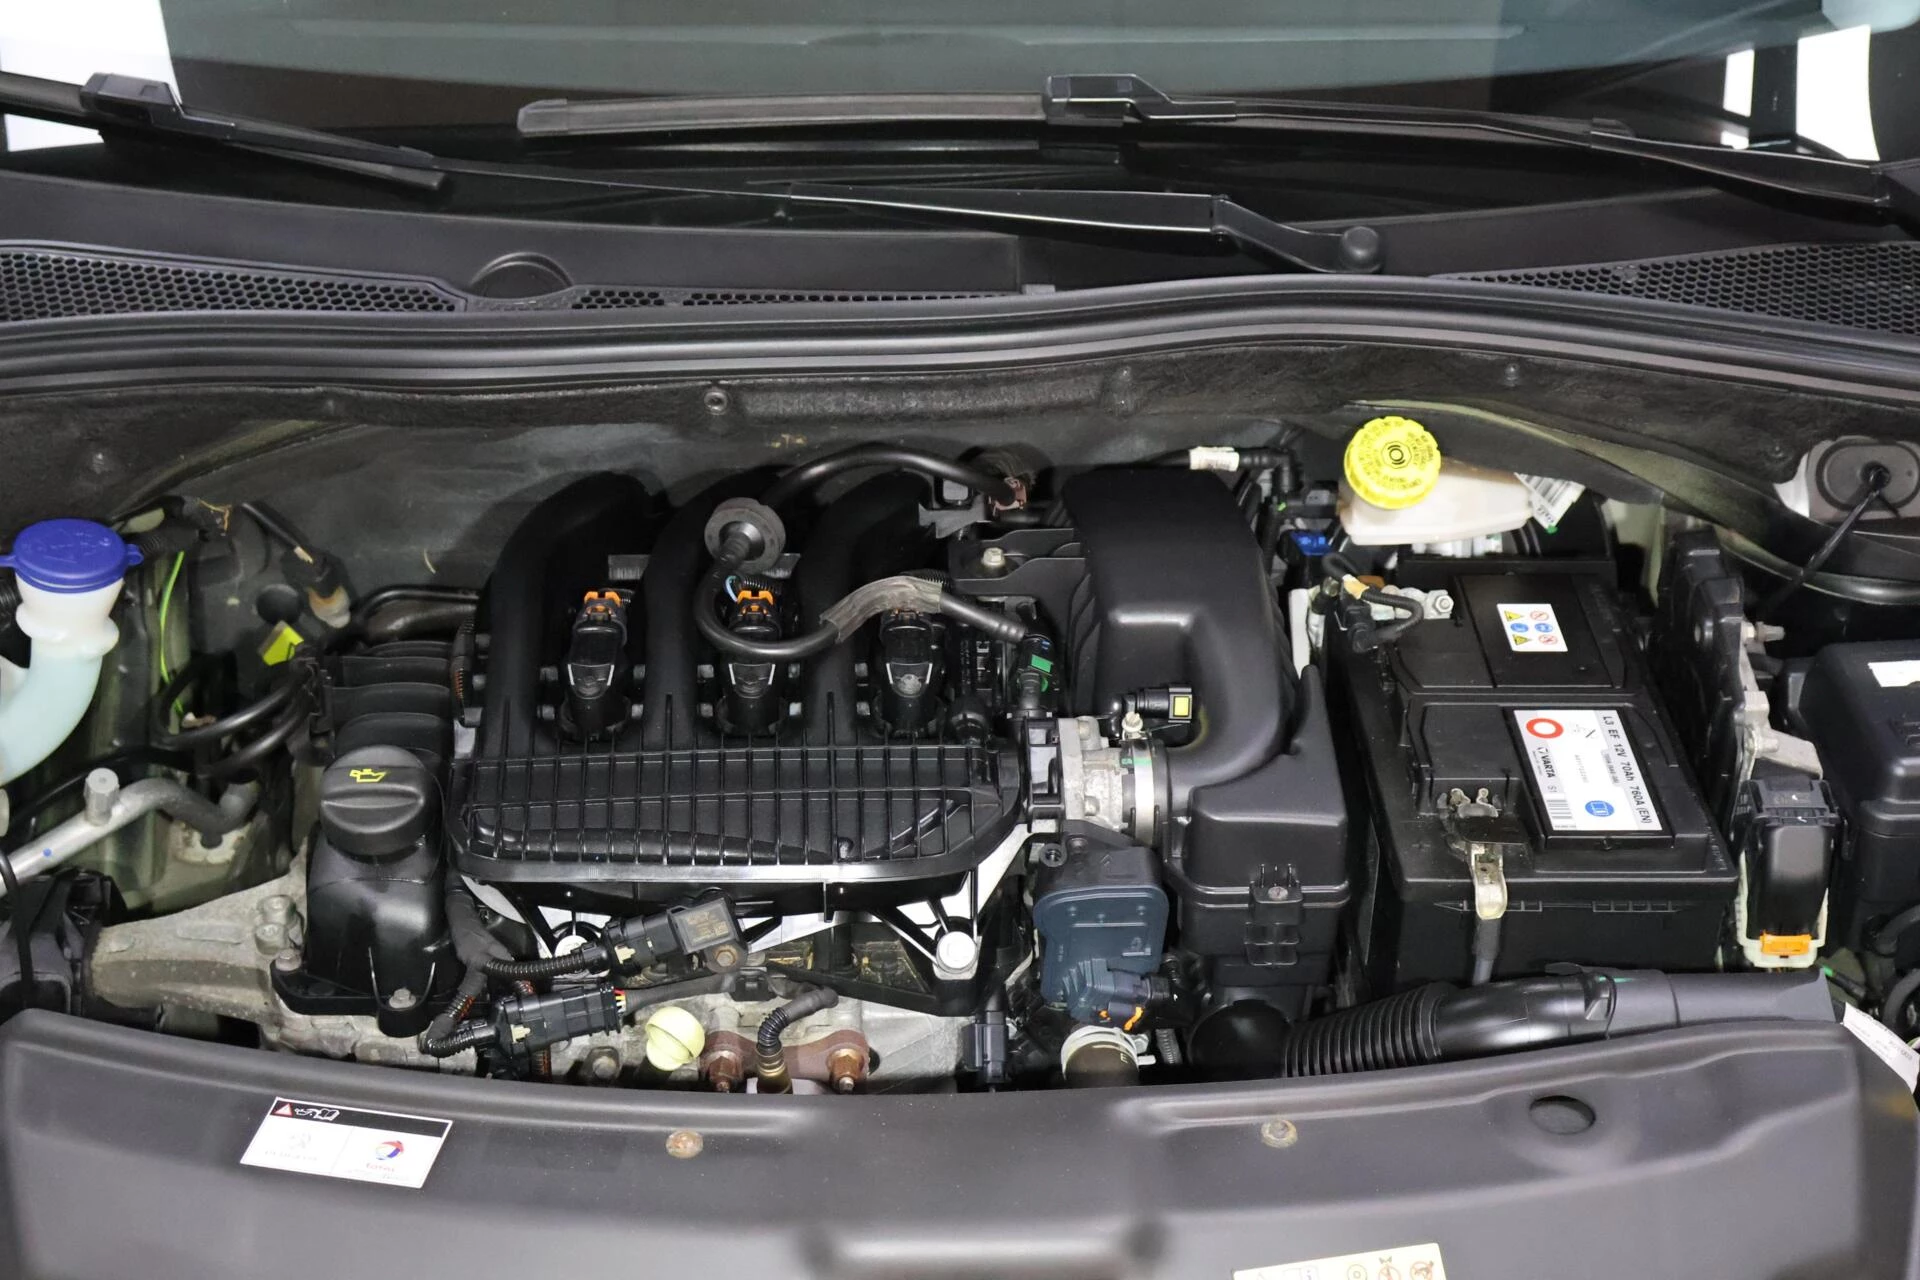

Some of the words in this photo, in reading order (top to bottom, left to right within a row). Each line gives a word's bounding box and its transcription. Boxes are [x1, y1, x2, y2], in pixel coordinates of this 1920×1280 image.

[1603, 716, 1614, 726] L3
[1613, 743, 1627, 758] 12V
[1541, 754, 1556, 778] VARTA
[1621, 762, 1636, 781] 70Ah
[1630, 786, 1645, 807] 760A
[1636, 805, 1652, 824] (EN)
